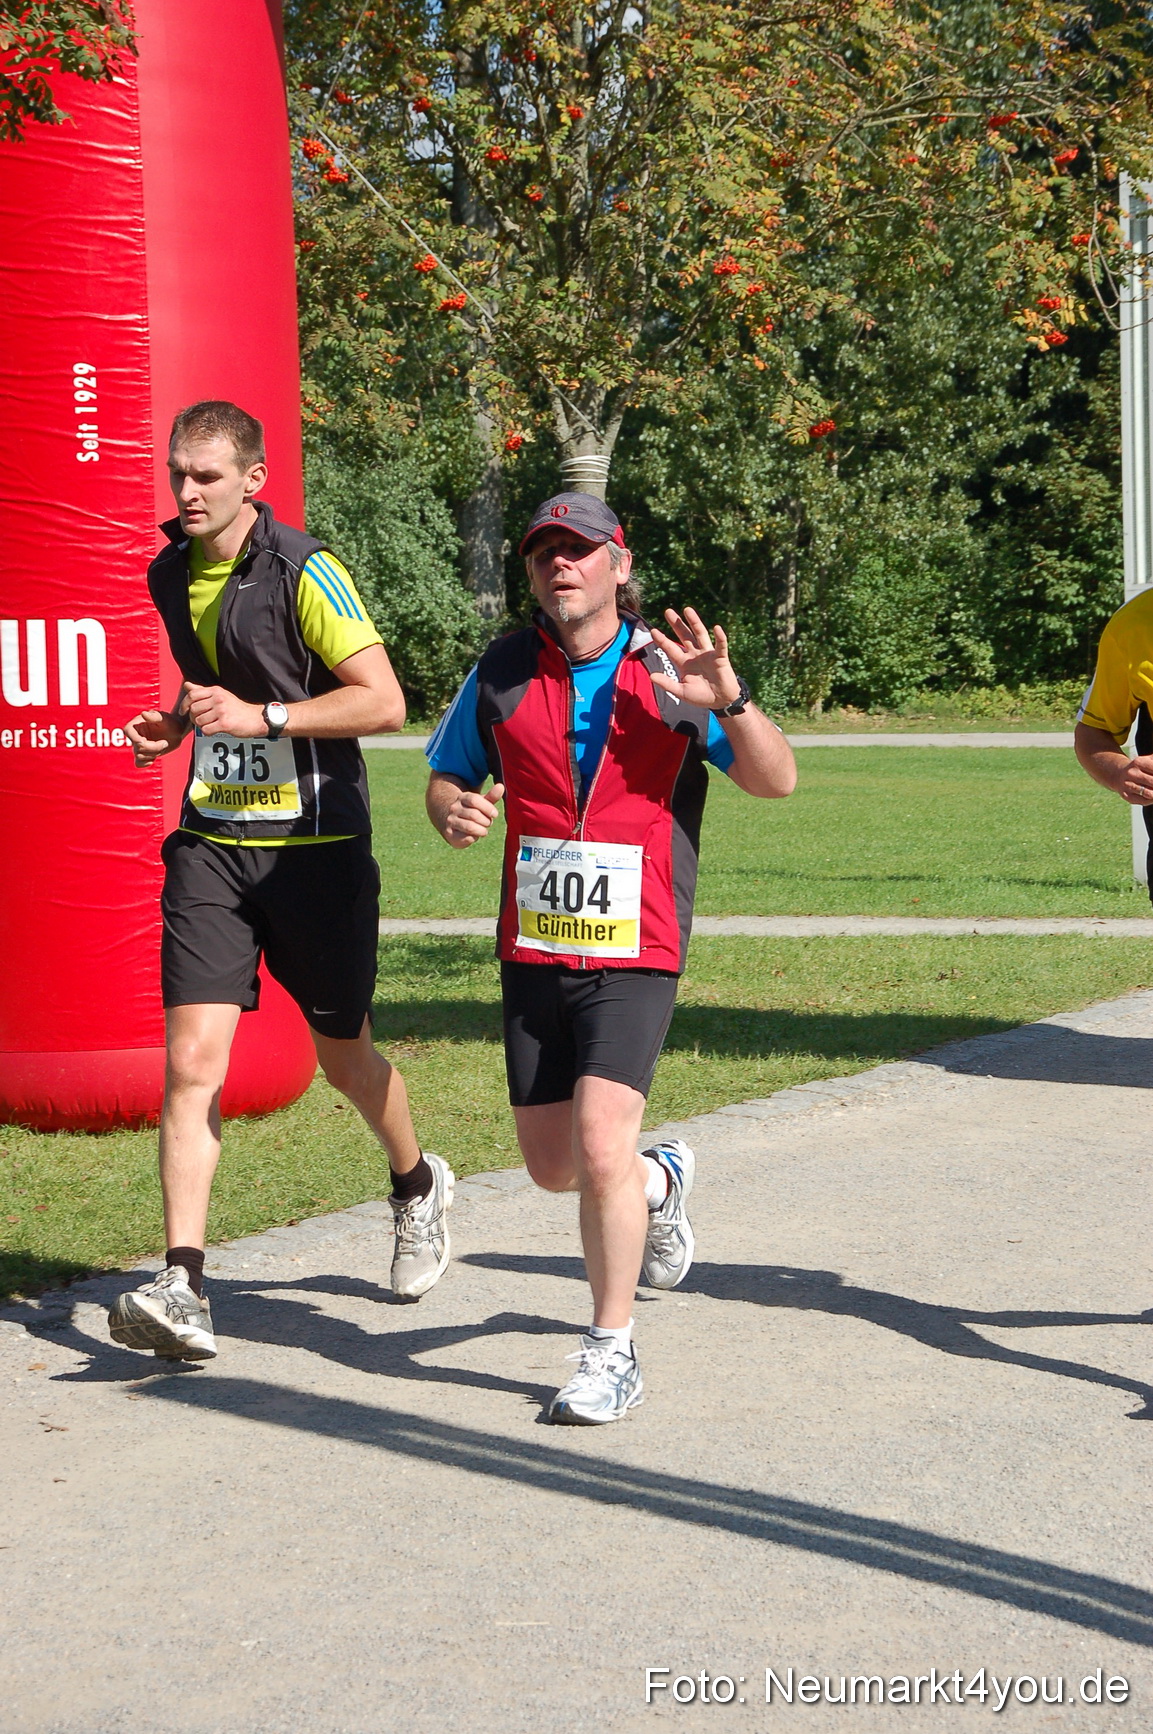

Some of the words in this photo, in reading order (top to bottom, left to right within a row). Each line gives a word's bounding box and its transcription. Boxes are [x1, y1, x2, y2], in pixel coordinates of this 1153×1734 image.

[72, 362, 98, 414] 1929
[76, 423, 100, 462] Seit
[0, 729, 23, 748] er
[30, 722, 58, 748] ist
[212, 741, 270, 782] 315
[207, 784, 281, 806] Manfred
[533, 846, 583, 862] PFLEIDERER
[539, 870, 611, 914] 404
[536, 912, 617, 941] Günther
